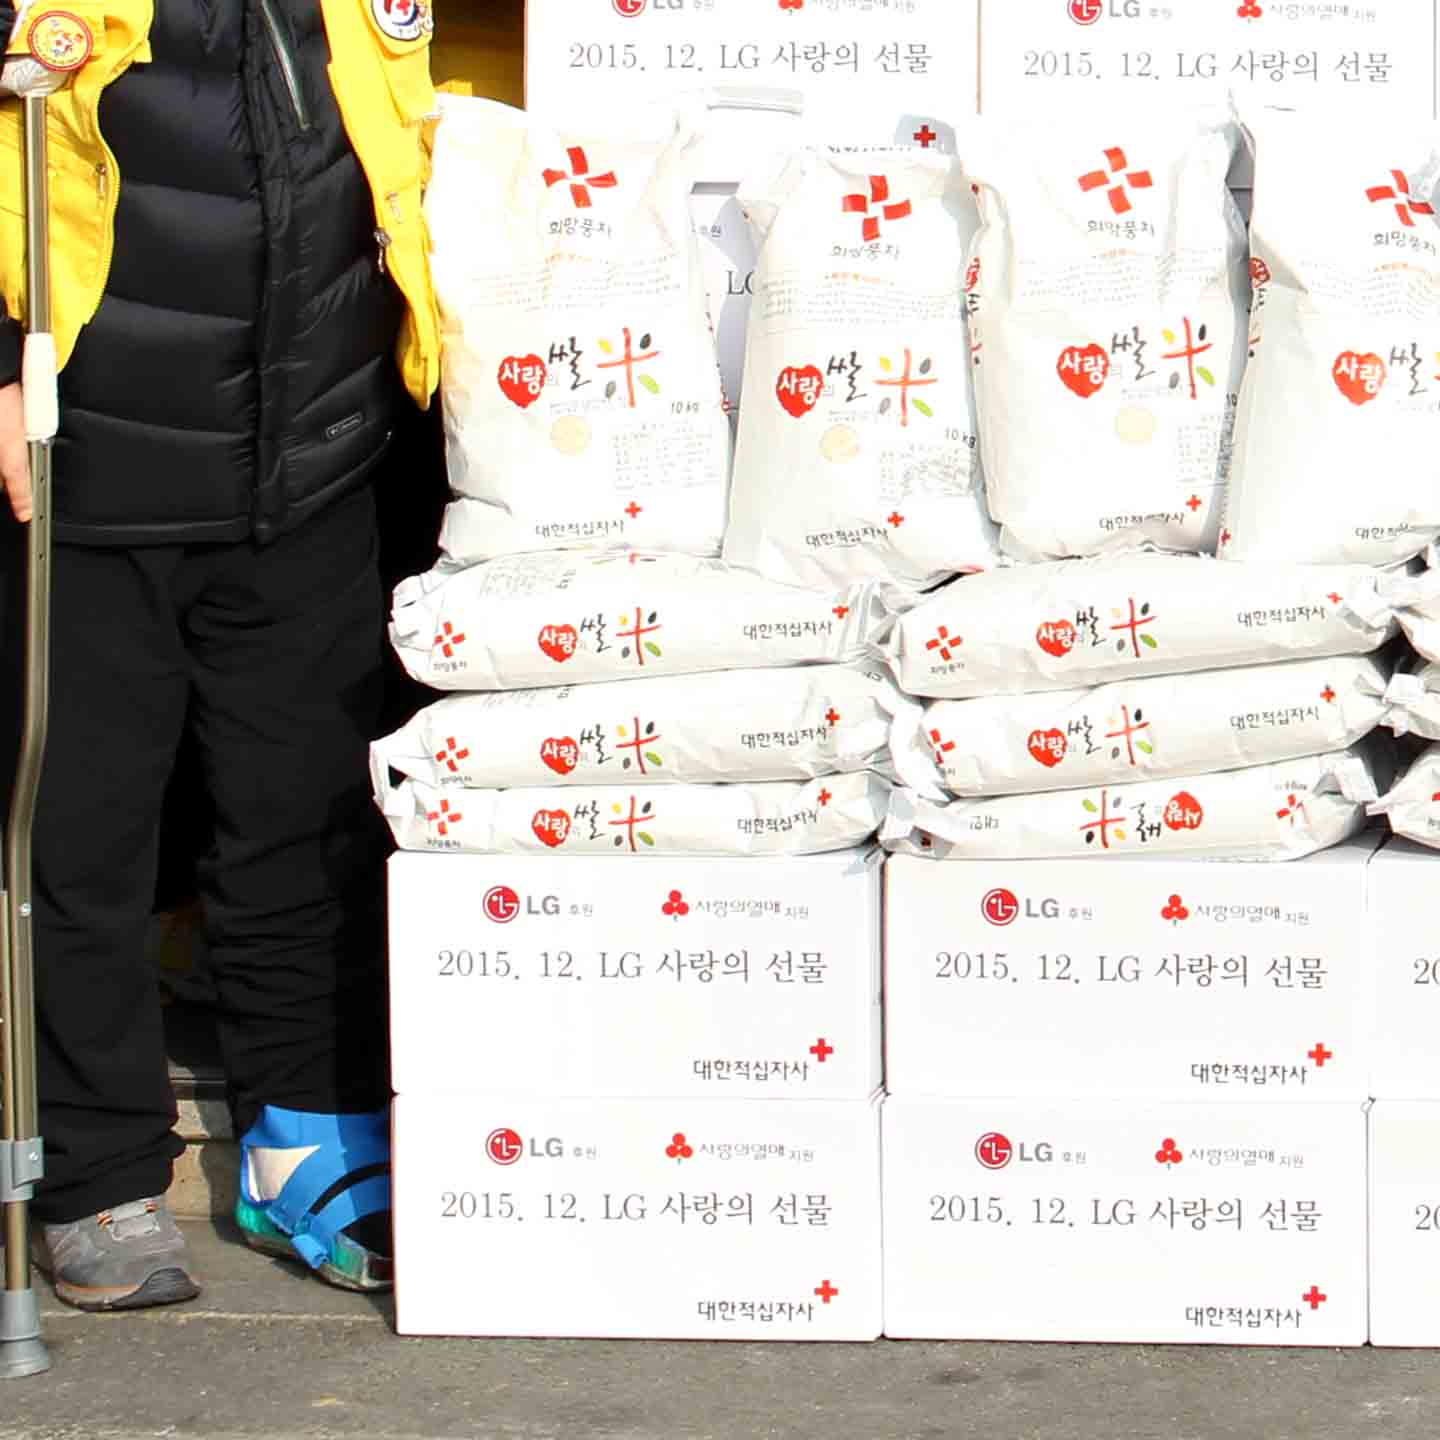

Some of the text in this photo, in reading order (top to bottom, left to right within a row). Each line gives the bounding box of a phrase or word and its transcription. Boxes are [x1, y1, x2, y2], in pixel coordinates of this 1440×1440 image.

[570, 42, 932, 73] 2015. 12. LG 사랑의 선물
[1024, 50, 1392, 83] 2015. 12. LG 사랑의 선물
[549, 218, 611, 238] 희망풍차
[1088, 220, 1154, 240] 희망풍차
[549, 336, 591, 390] 쌀
[1389, 342, 1426, 396] 쌀
[536, 520, 624, 538] 대한적십자사
[580, 614, 611, 653] 쌀
[744, 621, 832, 640] 대한적십자사
[527, 896, 560, 915] LG
[1026, 898, 1059, 918] LG
[438, 950, 827, 983] 2015. 12. LG 사랑의 선물
[936, 952, 1328, 989] 2015. 12. LG 사랑의 선물
[1192, 1064, 1307, 1085] 대한적십자사
[530, 1138, 563, 1157] LG
[930, 1195, 1322, 1231] 2015. 12. LG 사랑의 선물
[698, 1301, 813, 1322] 대한적십자사
